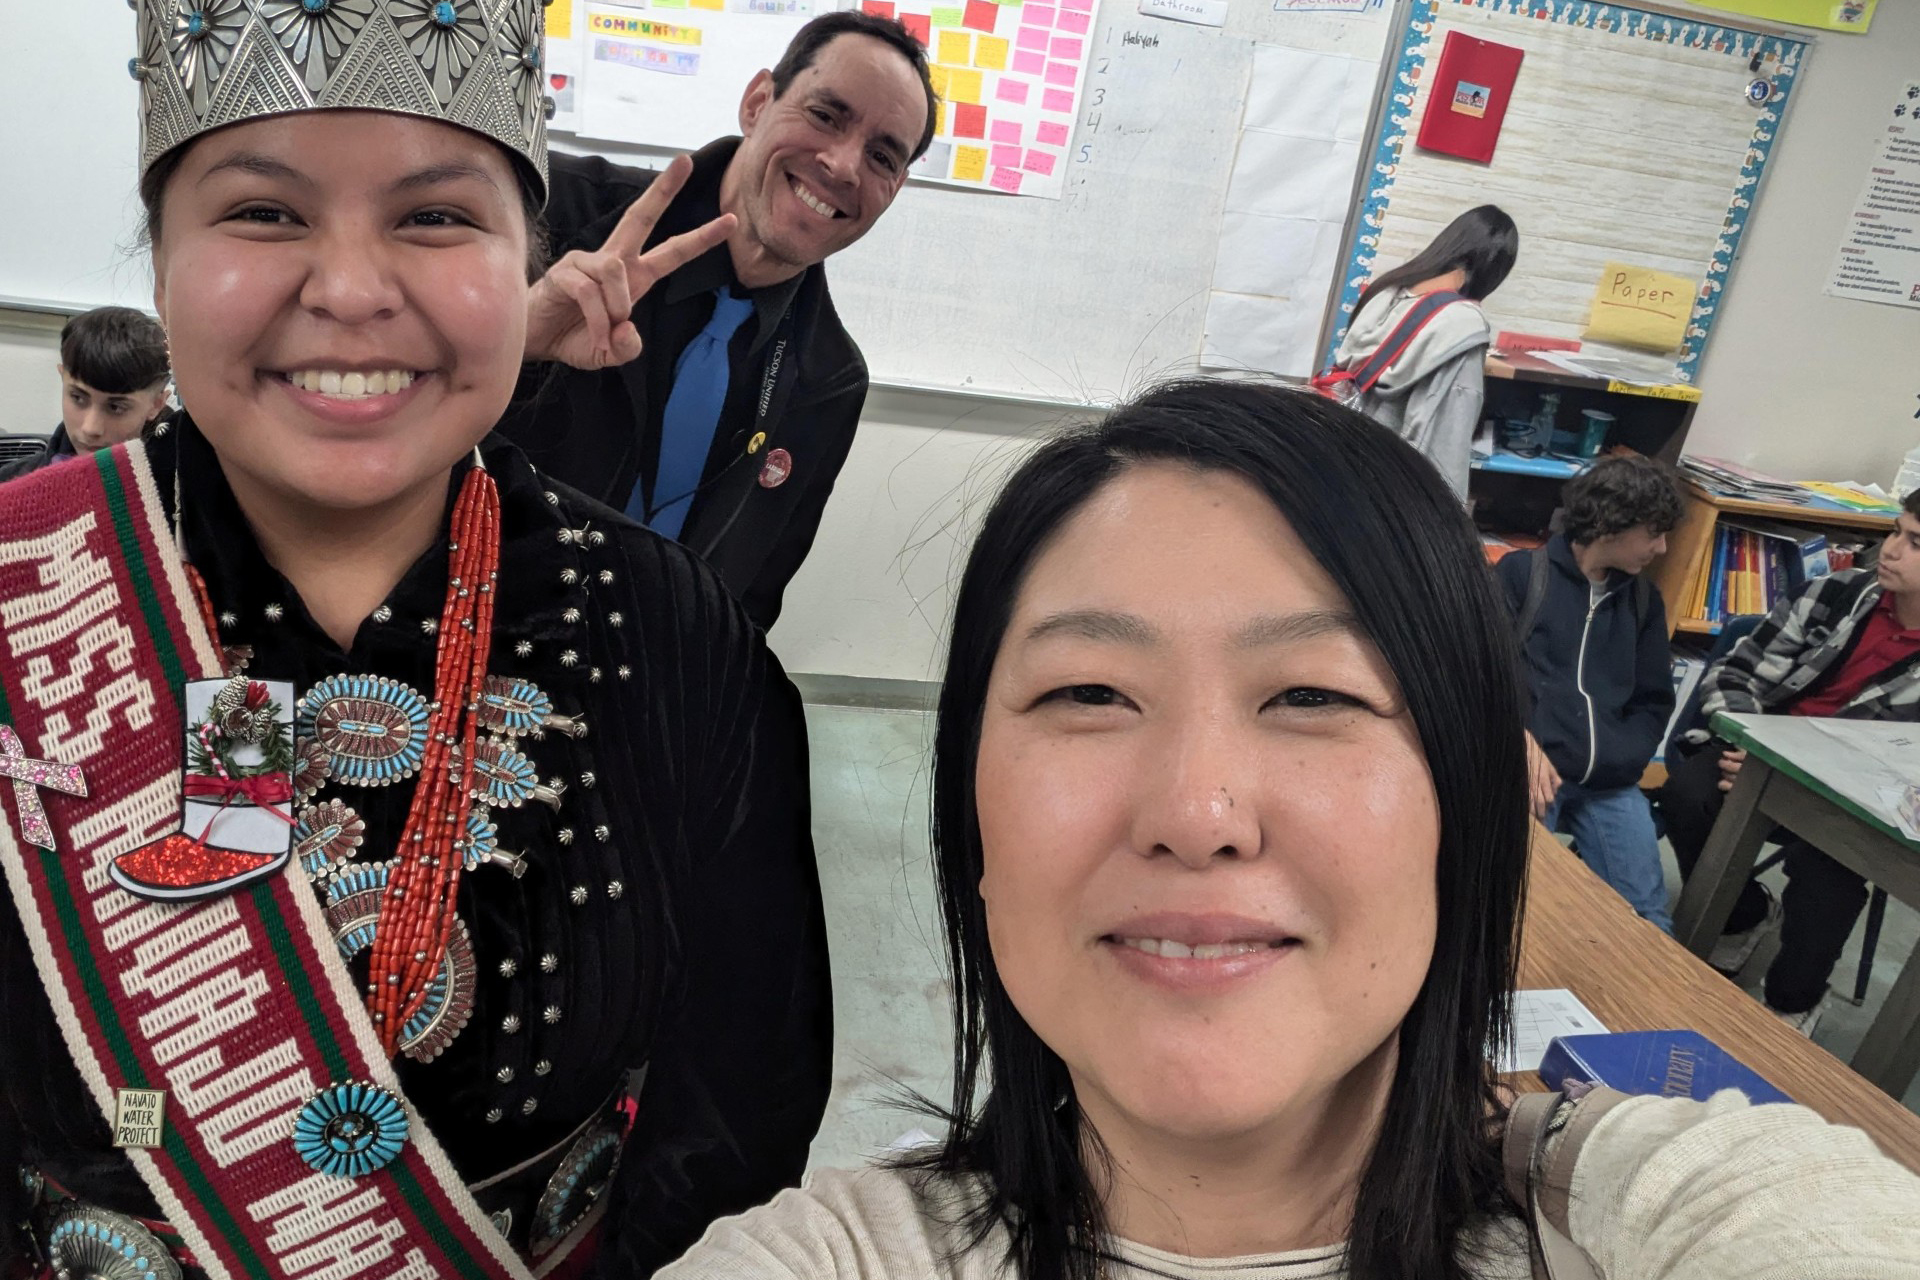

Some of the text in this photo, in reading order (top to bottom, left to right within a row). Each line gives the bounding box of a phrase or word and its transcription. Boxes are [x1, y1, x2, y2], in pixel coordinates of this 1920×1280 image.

[1092, 88, 1106, 106] 3
[1611, 271, 1675, 305] Paper
[769, 340, 787, 377] TUCSON
[0, 511, 155, 766] MISS
[124, 1093, 157, 1109] NAVAJO
[123, 1110, 154, 1126] WATER
[117, 1127, 159, 1145] PROJECT
